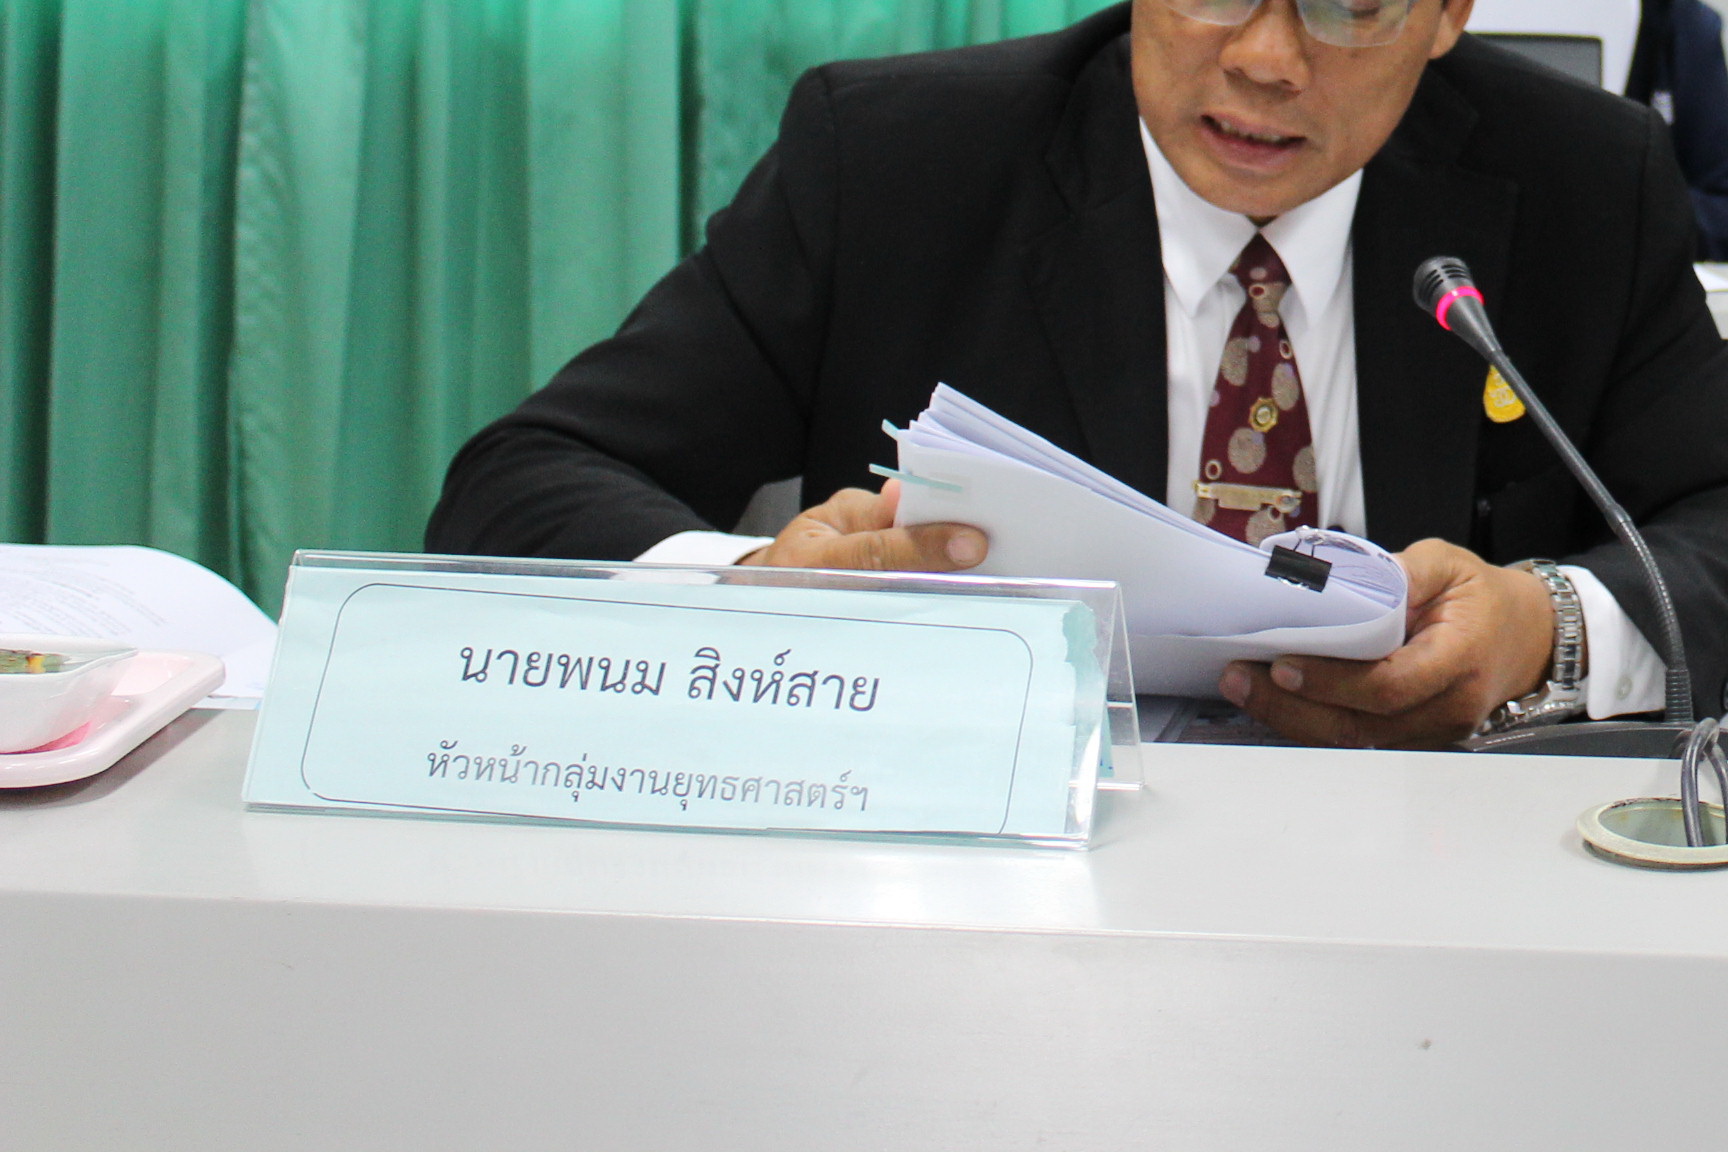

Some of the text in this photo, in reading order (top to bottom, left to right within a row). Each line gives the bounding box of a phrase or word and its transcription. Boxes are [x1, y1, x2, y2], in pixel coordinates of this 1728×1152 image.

[459, 646, 881, 712] นายพนม สิงห์สาย
[426, 739, 869, 812] หัวหน้ากลุ่มงานยุทธศาสตร์ฯ
